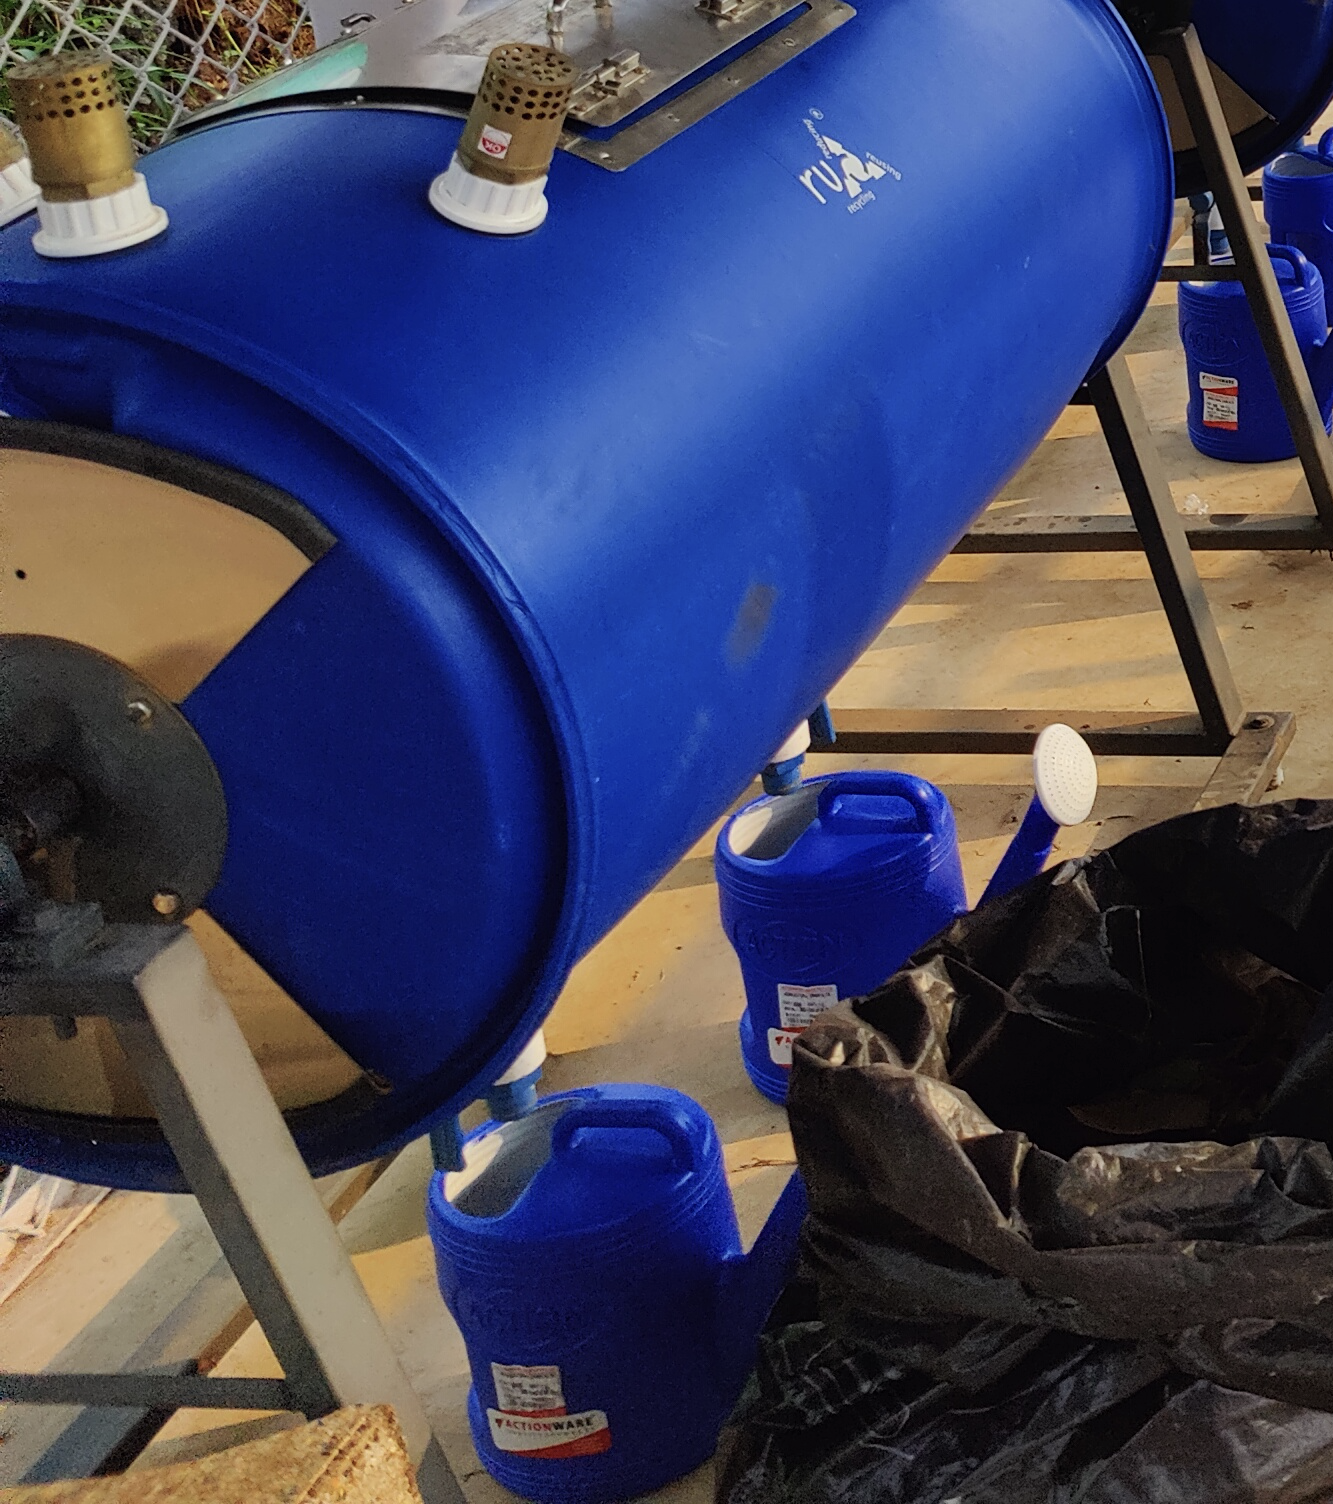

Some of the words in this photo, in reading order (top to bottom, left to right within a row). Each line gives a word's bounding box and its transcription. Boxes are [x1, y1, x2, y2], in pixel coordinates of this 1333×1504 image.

[485, 139, 502, 154] OK
[865, 151, 902, 181] reusing
[505, 1417, 594, 1431] ACTIONWARE
